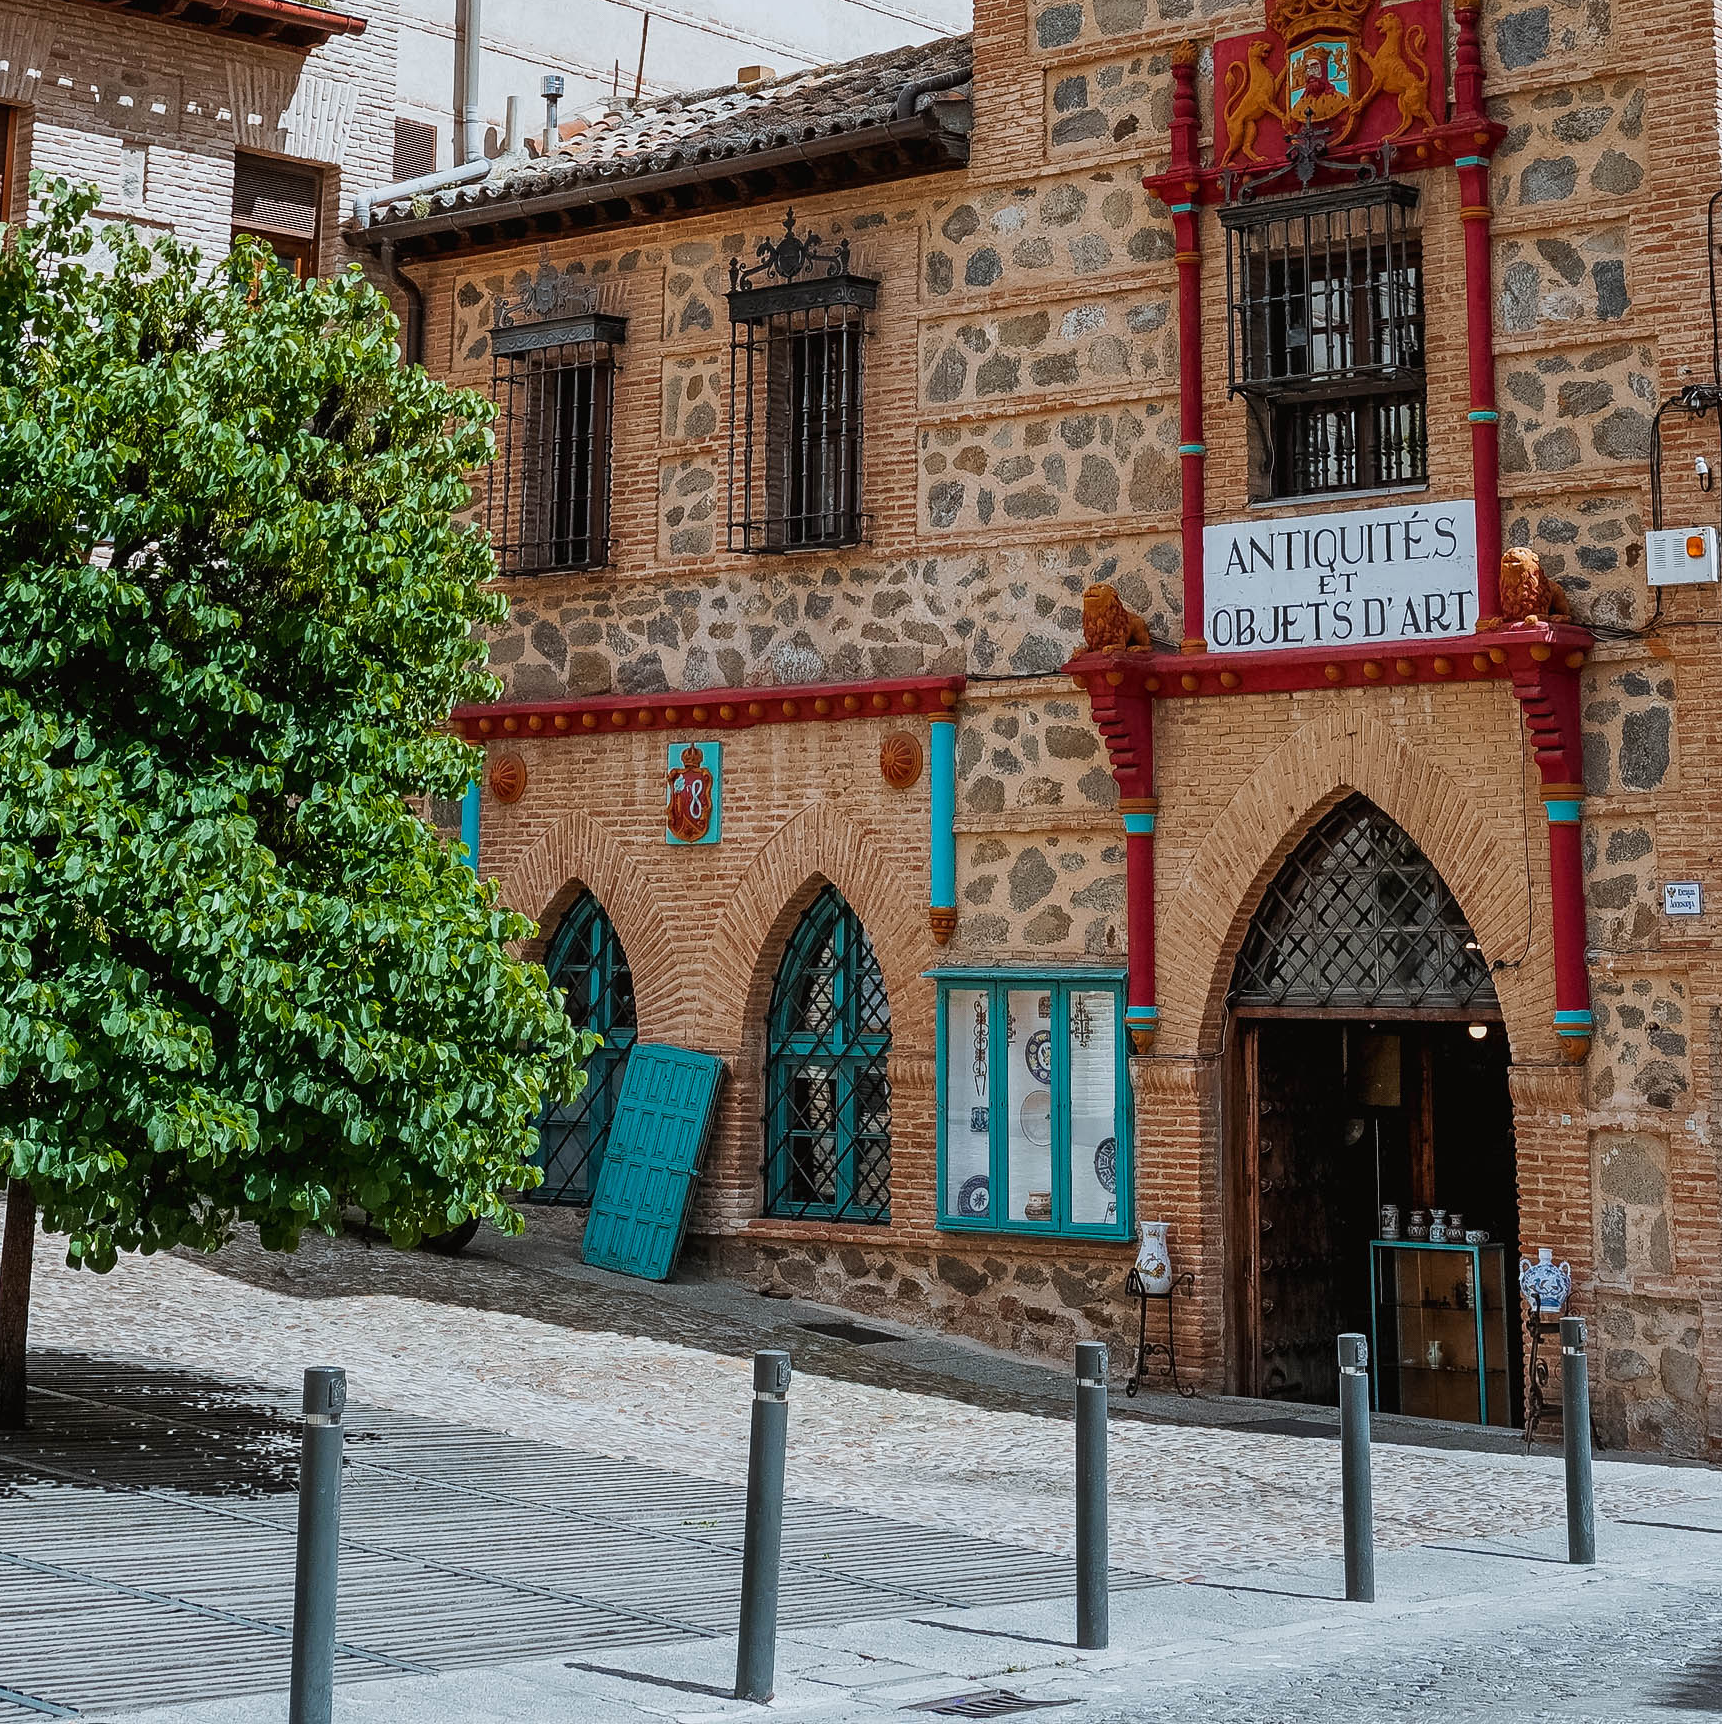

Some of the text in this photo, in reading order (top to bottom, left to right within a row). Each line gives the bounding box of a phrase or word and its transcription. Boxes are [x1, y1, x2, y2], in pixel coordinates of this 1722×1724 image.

[1224, 510, 1459, 576] ANTIQUITÉS
[1318, 571, 1358, 597] ET
[1212, 589, 1474, 647] OBJETS D'ART
